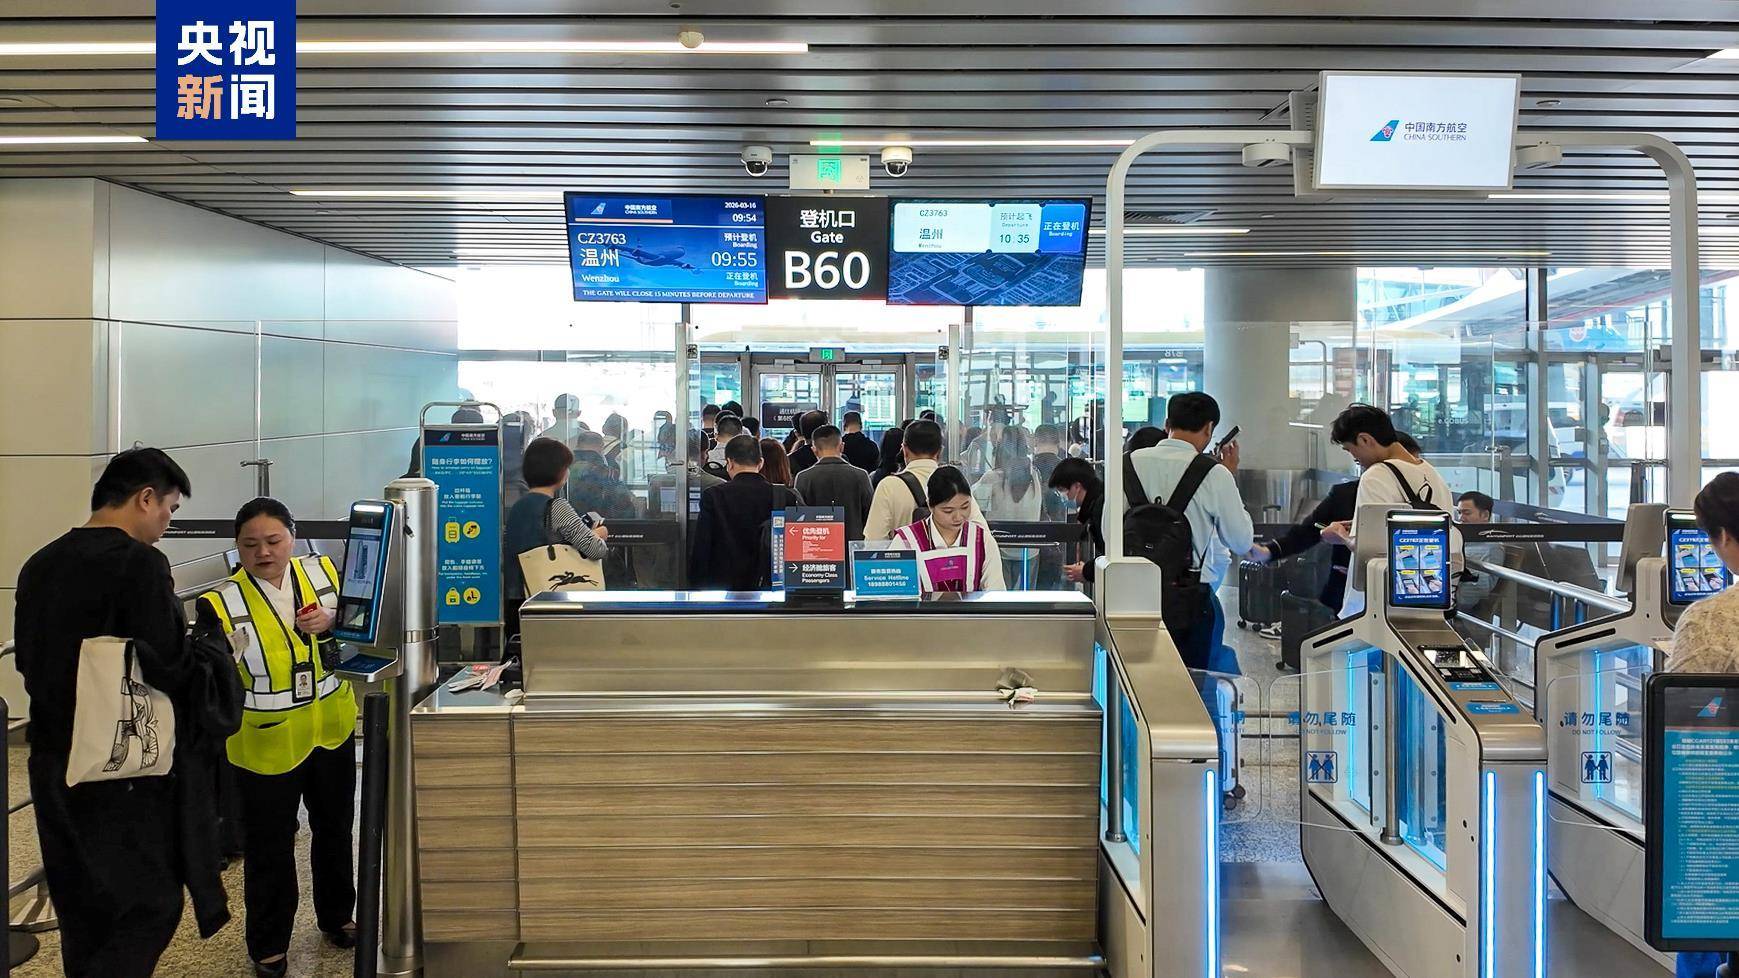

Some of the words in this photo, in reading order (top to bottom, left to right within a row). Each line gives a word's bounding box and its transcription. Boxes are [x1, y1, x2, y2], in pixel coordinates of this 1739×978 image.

[1405, 121, 1467, 133] 中国南方航空
[1404, 133, 1426, 141] CHINA
[1428, 133, 1467, 141] SOUTHERN
[732, 213, 757, 223] 09:54
[800, 209, 856, 229] 登机口
[919, 209, 948, 217] CZ3763
[1043, 221, 1080, 231] 正在登机
[577, 232, 627, 245] CZ3763
[724, 232, 757, 242] 预计登机
[810, 230, 844, 244] Gate
[919, 228, 944, 240] 温州
[580, 248, 620, 267] 温州
[711, 251, 757, 267] 09:55
[726, 271, 758, 281] 正在登机
[784, 250, 871, 290] B60
[581, 274, 620, 283] Wenzhou
[802, 527, 830, 535] 优先登机
[1288, 711, 1357, 727] 请勿尾随
[1563, 711, 1631, 727] 请勿尾随
